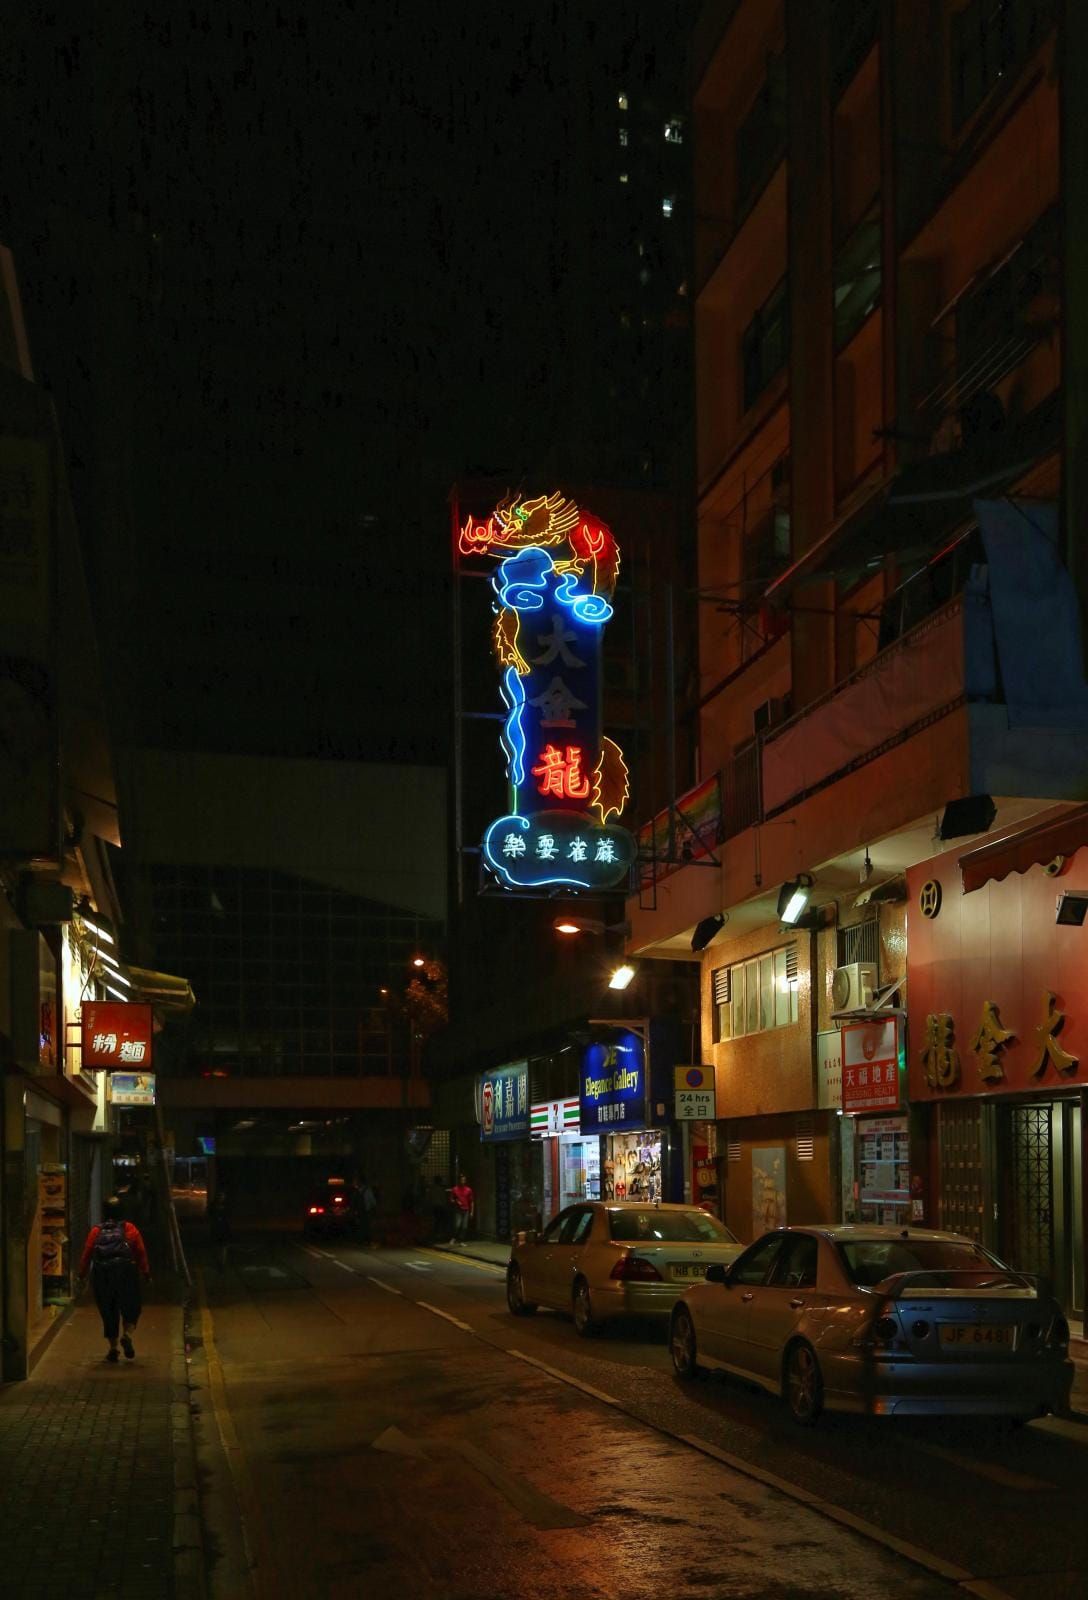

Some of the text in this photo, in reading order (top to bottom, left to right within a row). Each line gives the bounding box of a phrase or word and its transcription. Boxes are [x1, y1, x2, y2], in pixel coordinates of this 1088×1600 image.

[530, 614, 591, 800] 大金龍
[92, 1032, 147, 1063] 粉麵
[585, 1068, 639, 1100] Elegance Gallery
[679, 1093, 711, 1103] 24 hrs
[683, 1104, 708, 1117] 全日
[944, 1328, 966, 1343] JF
